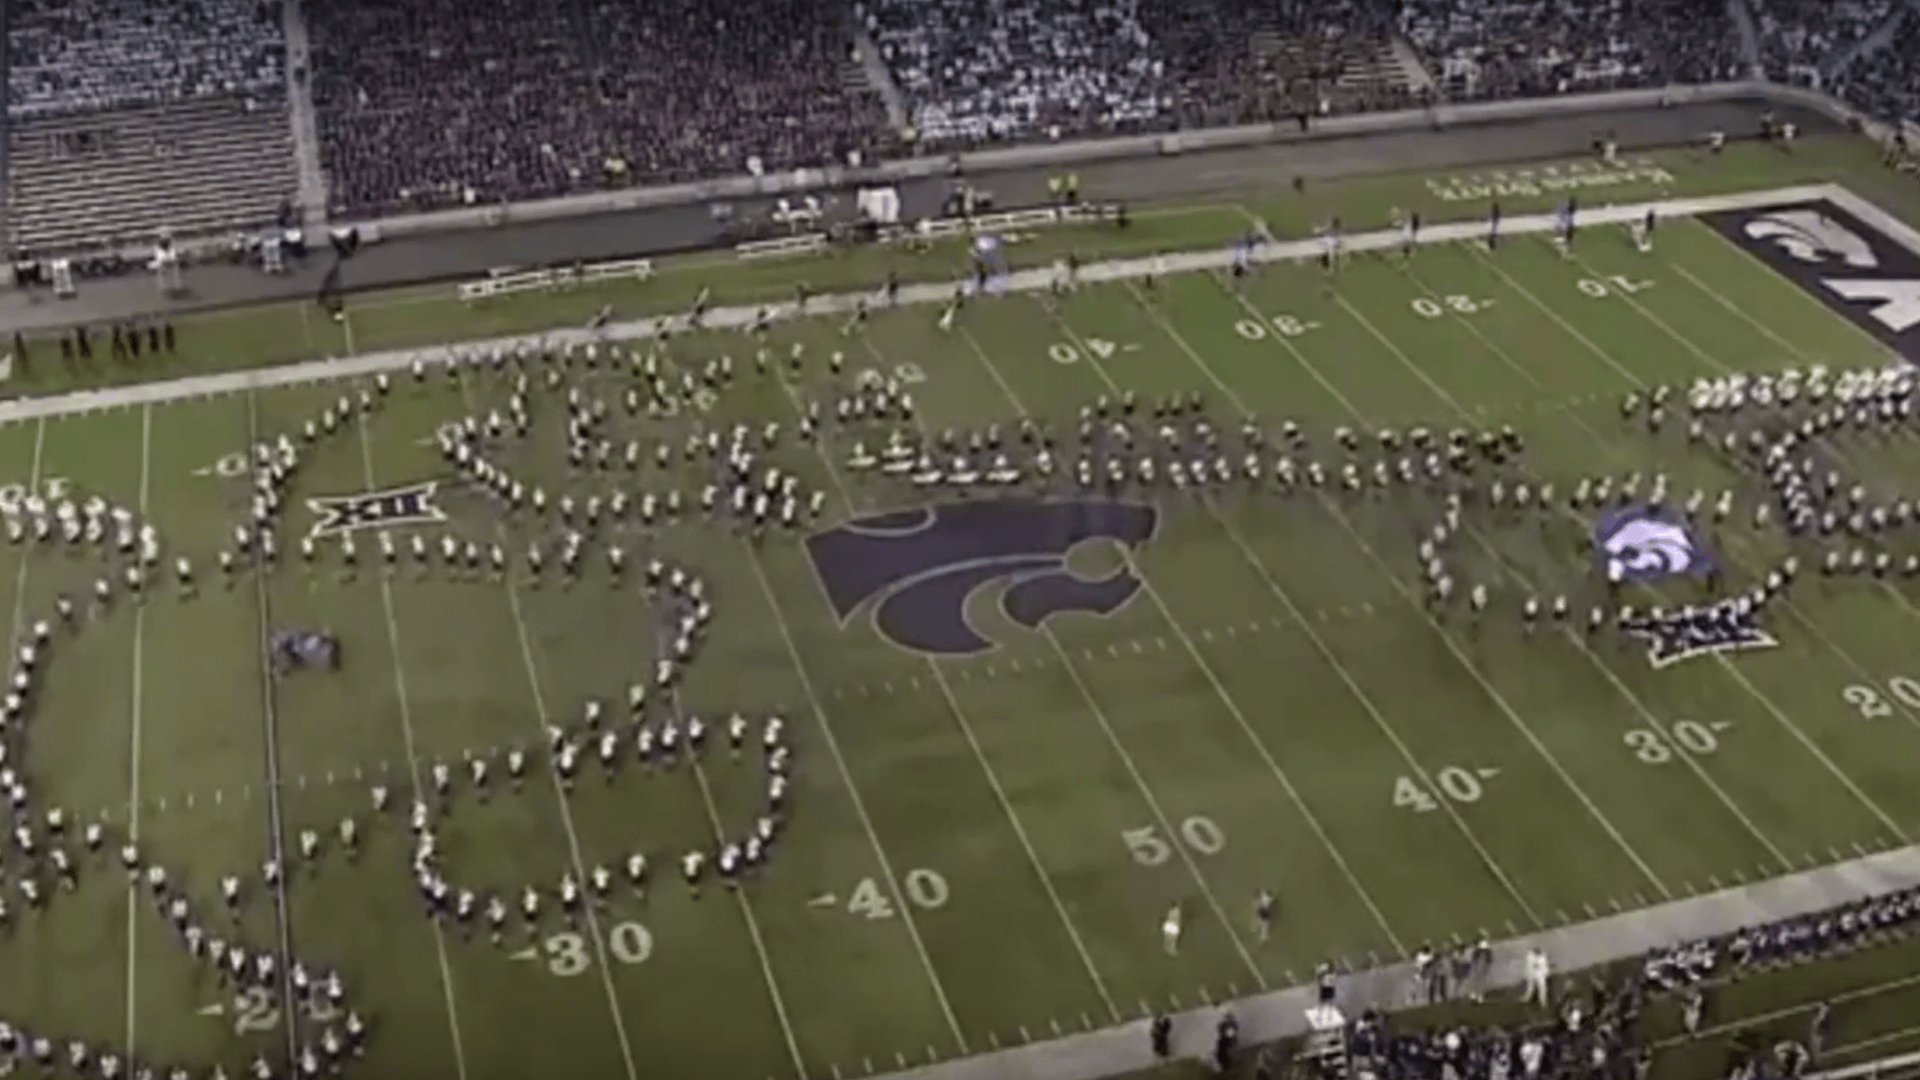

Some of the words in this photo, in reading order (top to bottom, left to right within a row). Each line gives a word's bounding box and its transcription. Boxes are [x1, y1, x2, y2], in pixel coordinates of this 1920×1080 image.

[1411, 294, 1478, 318] 20
[1577, 275, 1641, 298] 10
[1235, 314, 1304, 341] 30
[1049, 338, 1116, 364] 40
[1843, 677, 1920, 720] 20
[1623, 720, 1718, 764] 30
[1393, 766, 1482, 813] 40
[1121, 815, 1225, 866] 50
[847, 868, 949, 921] 40
[546, 921, 655, 977] 30
